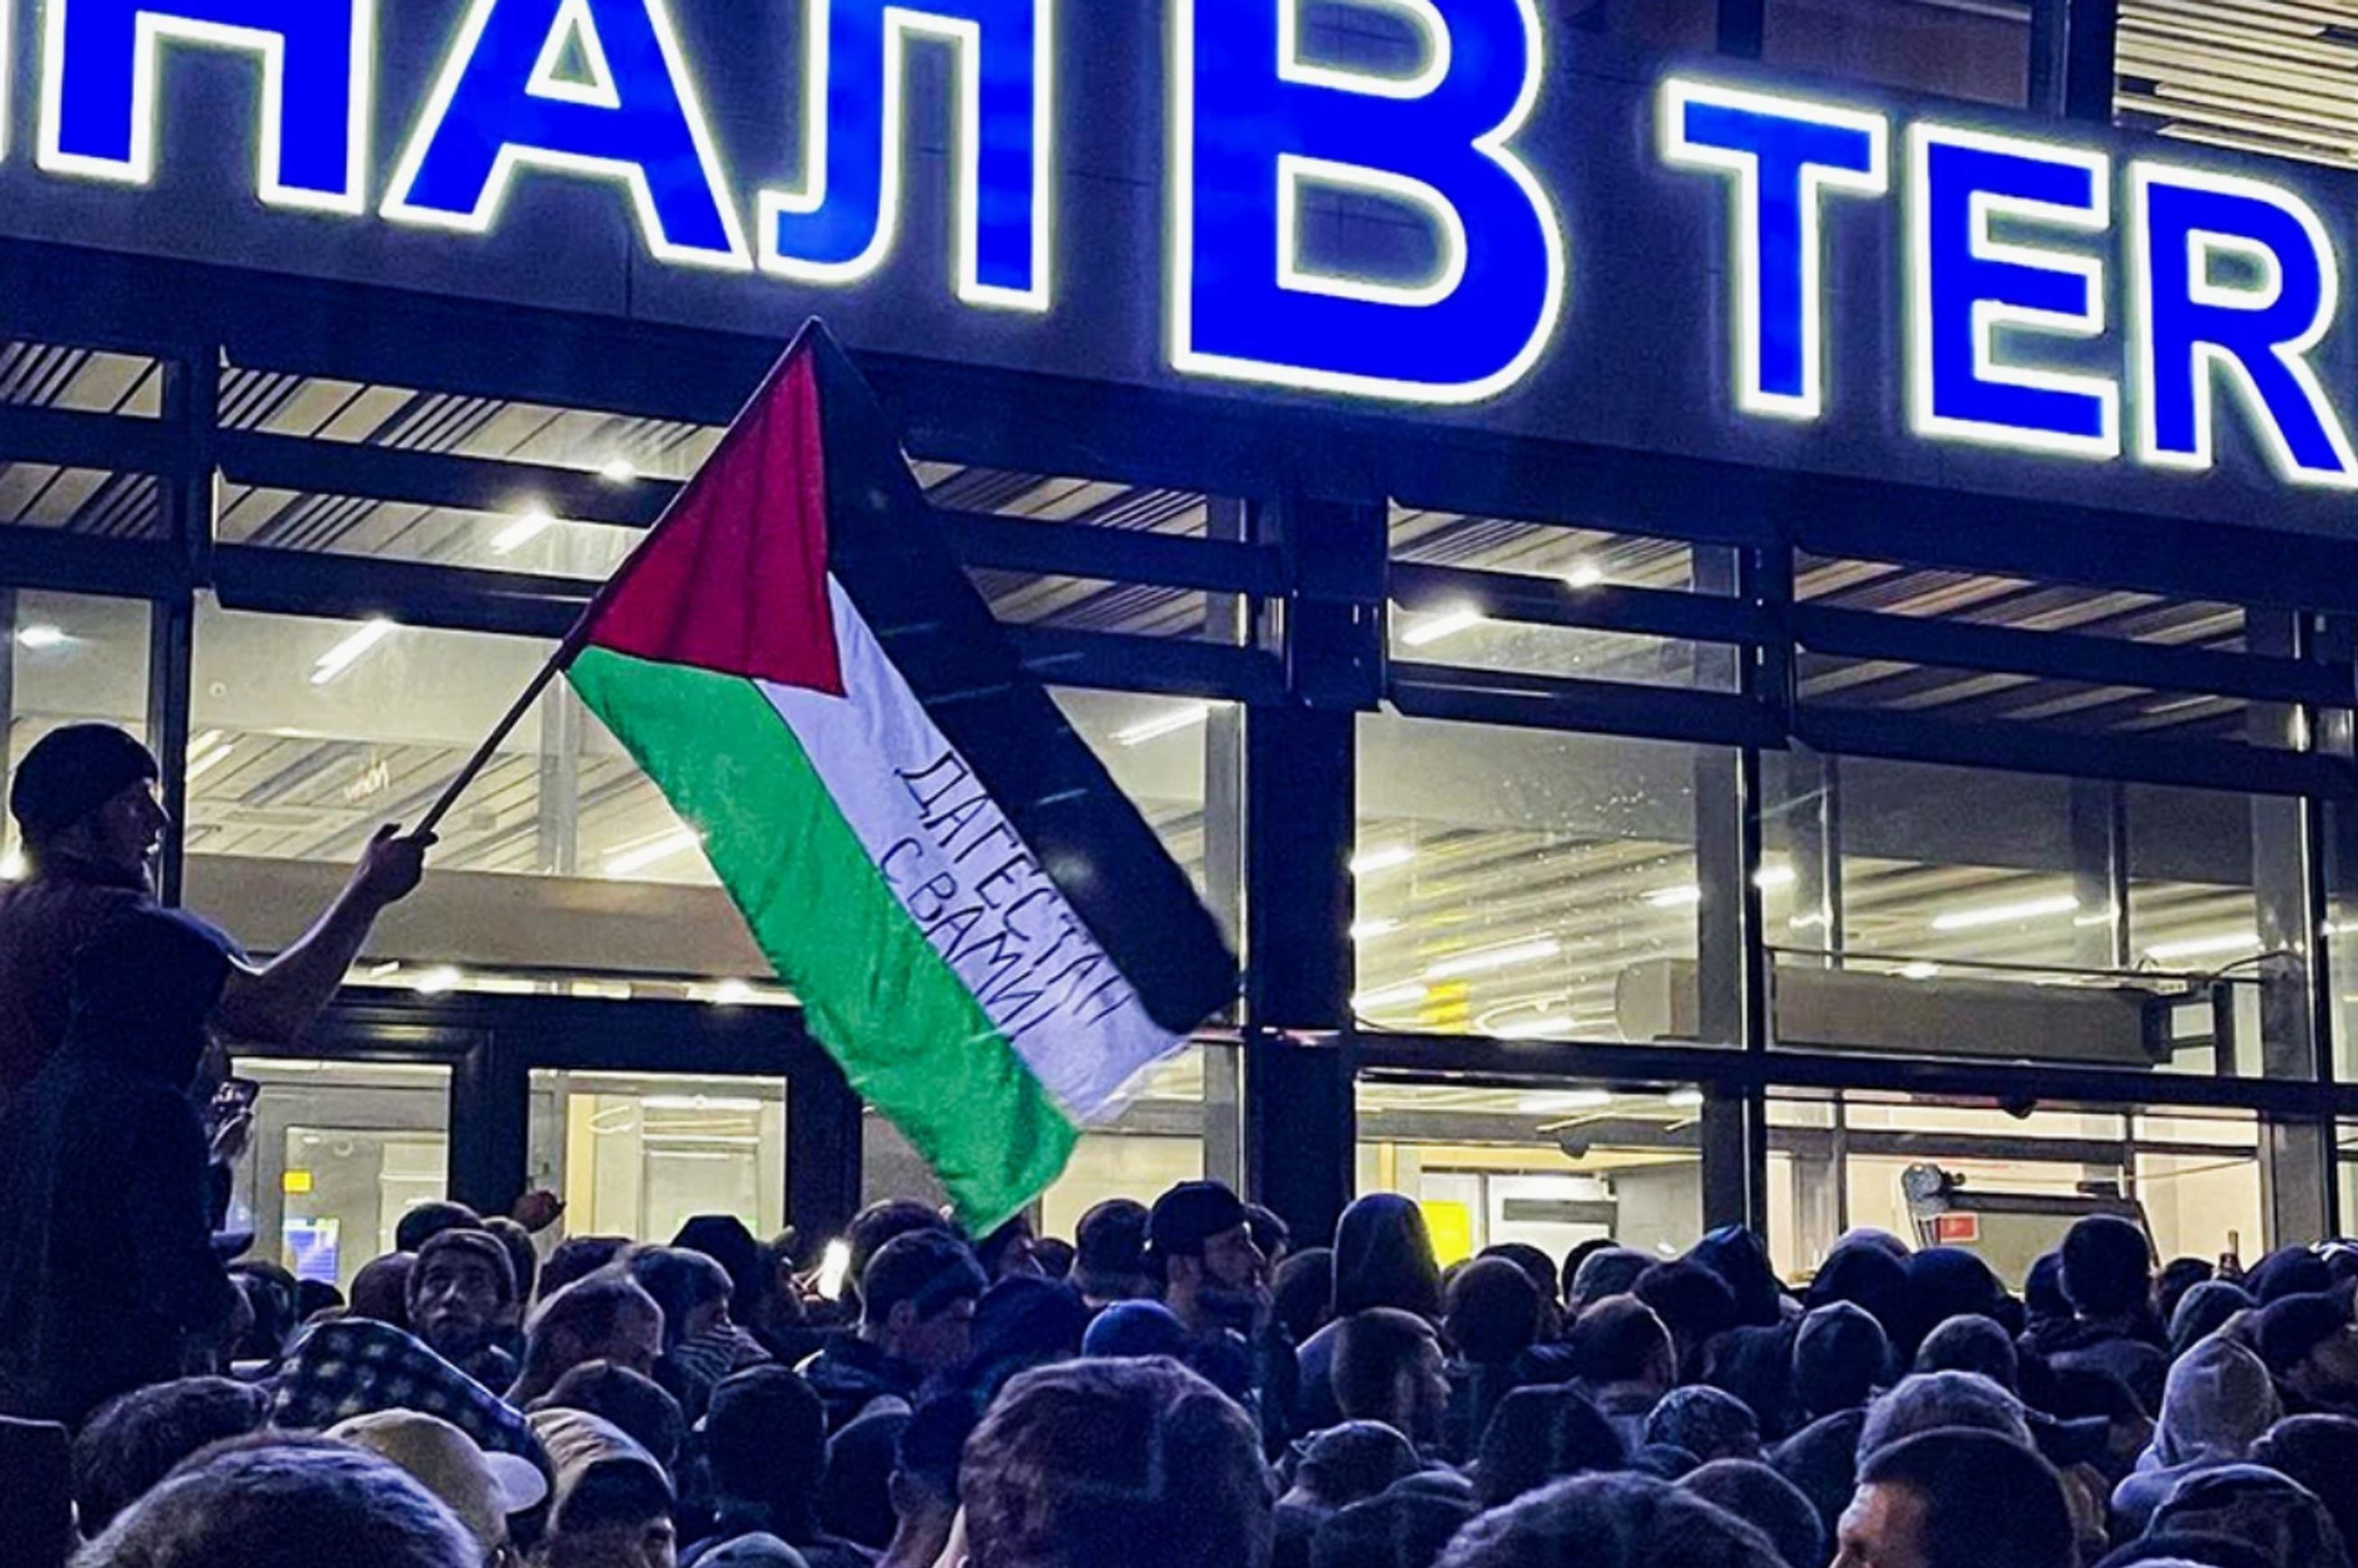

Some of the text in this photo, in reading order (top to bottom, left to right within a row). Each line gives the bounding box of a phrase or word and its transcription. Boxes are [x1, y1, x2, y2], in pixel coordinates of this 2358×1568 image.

[1660, 77, 2358, 488] TER
[880, 836, 923, 885] С
[892, 750, 1134, 1028] ДАГЕСТАН
